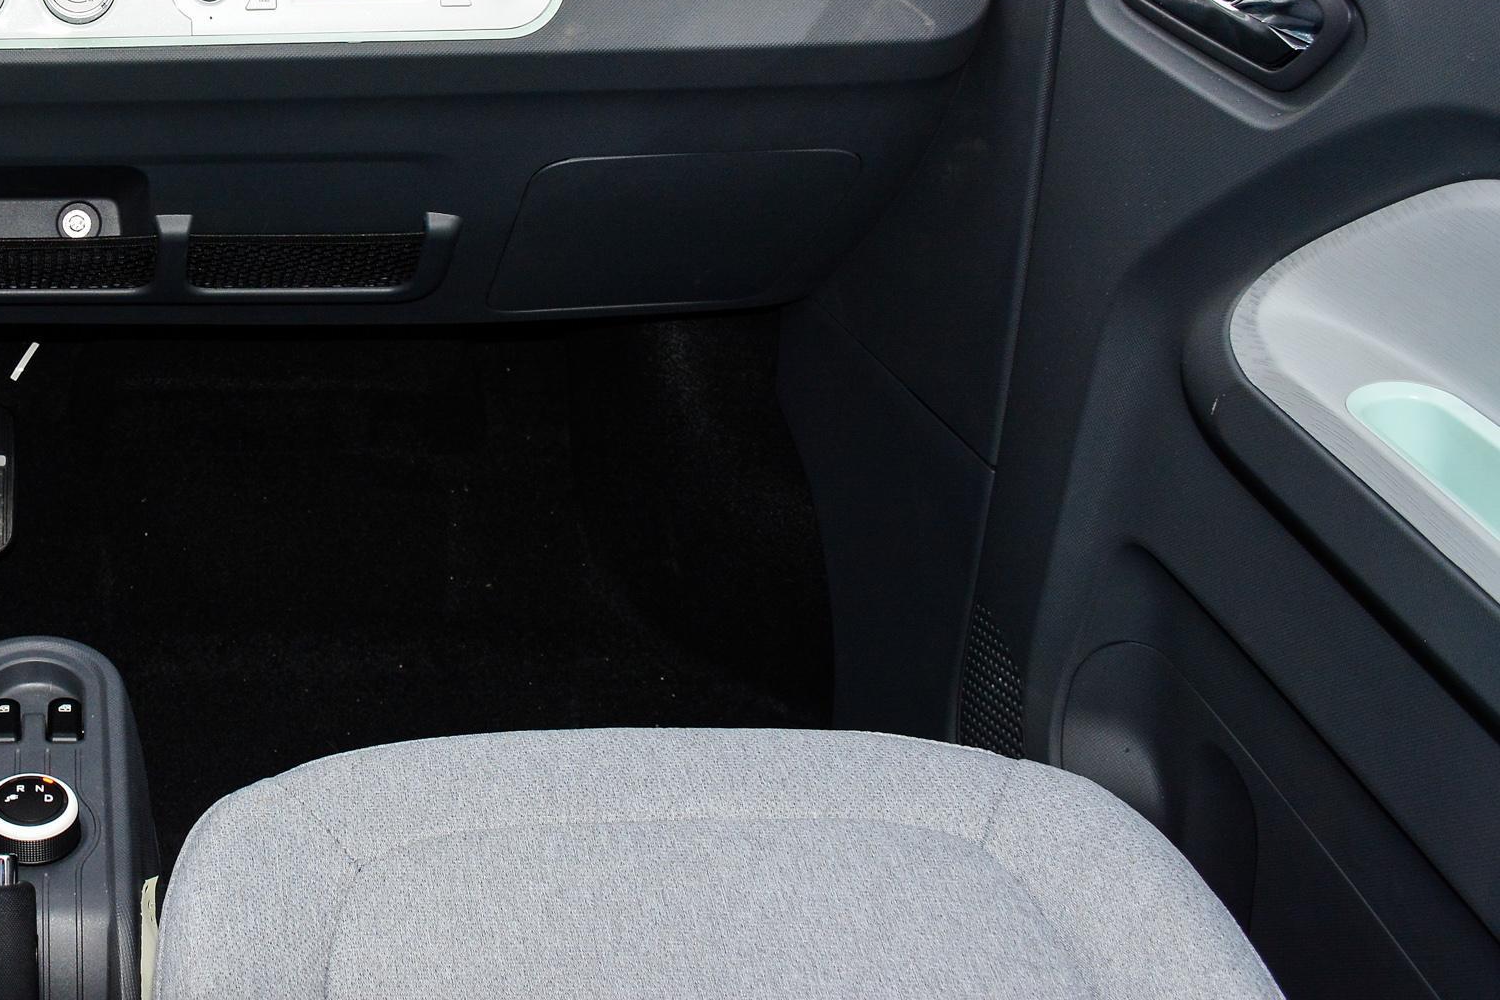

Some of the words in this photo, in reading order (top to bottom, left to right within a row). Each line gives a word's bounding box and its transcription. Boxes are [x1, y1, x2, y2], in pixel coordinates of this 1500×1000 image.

[16, 784, 25, 792] R
[35, 784, 44, 792] N
[44, 794, 53, 802] D
